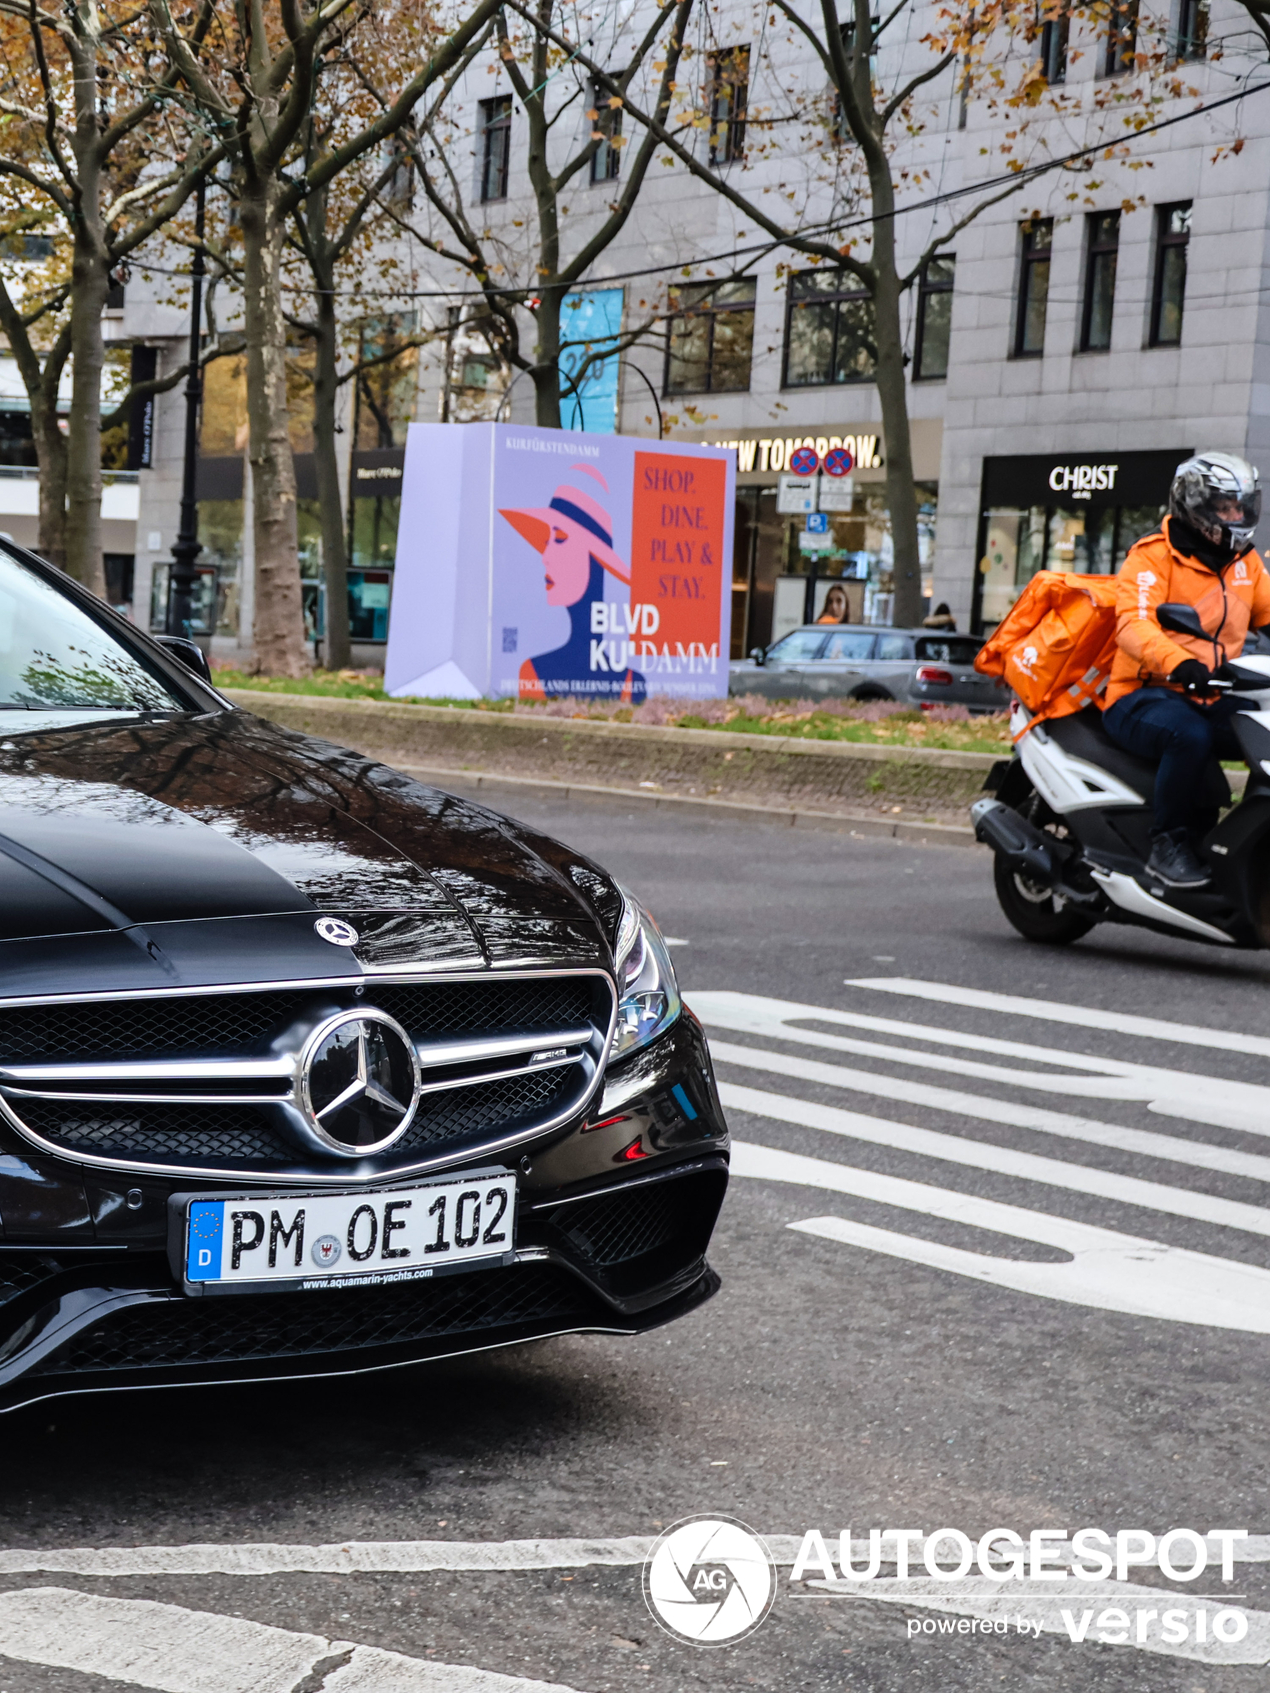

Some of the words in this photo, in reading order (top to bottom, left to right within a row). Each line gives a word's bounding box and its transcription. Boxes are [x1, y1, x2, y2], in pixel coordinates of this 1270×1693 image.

[505, 436, 601, 458] KURFÜRSTENDAMM
[643, 466, 696, 494] SHOP.
[1049, 465, 1119, 491] CHRIST
[661, 504, 709, 531] DINE.
[651, 538, 697, 564] PLAY
[700, 541, 714, 566] &
[658, 574, 707, 600] STAY.
[590, 601, 660, 636] BLVD
[589, 638, 719, 675] KU'DAMM
[198, 1249, 212, 1266] D
[230, 1208, 306, 1270] PM
[346, 1200, 412, 1262] OE
[424, 1187, 508, 1254] 102
[303, 1269, 434, 1289] www.aquamarin-yachts.com
